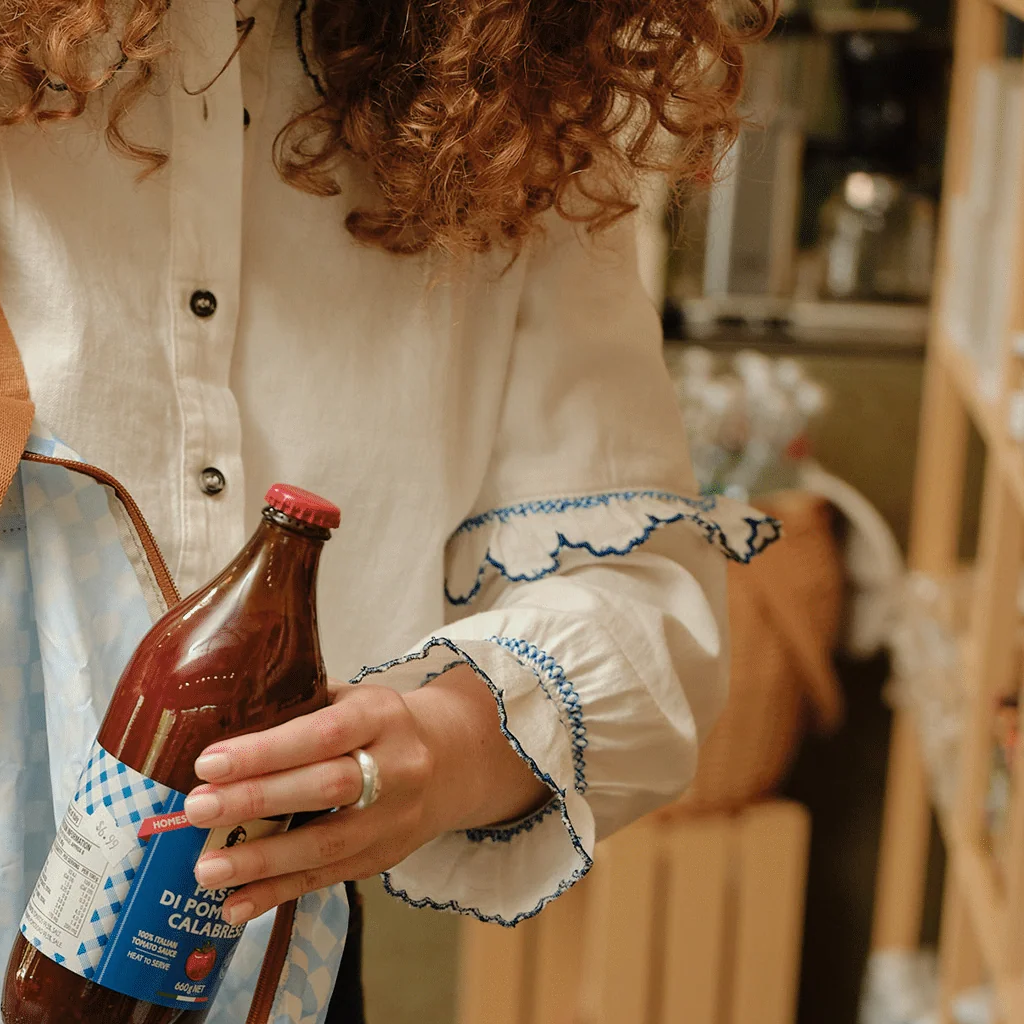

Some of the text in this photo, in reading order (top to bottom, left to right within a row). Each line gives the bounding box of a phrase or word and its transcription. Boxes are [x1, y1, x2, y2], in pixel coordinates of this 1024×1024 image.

[152, 814, 187, 829] HOMES
[95, 820, 120, 850] $6.99
[194, 884, 235, 902] PAS
[159, 889, 222, 920] DI POM
[131, 936, 178, 958] TOMATO SAUCE
[138, 929, 178, 949] 100% ITALIAN
[127, 950, 144, 962] HEAT
[151, 959, 171, 971] SERVE
